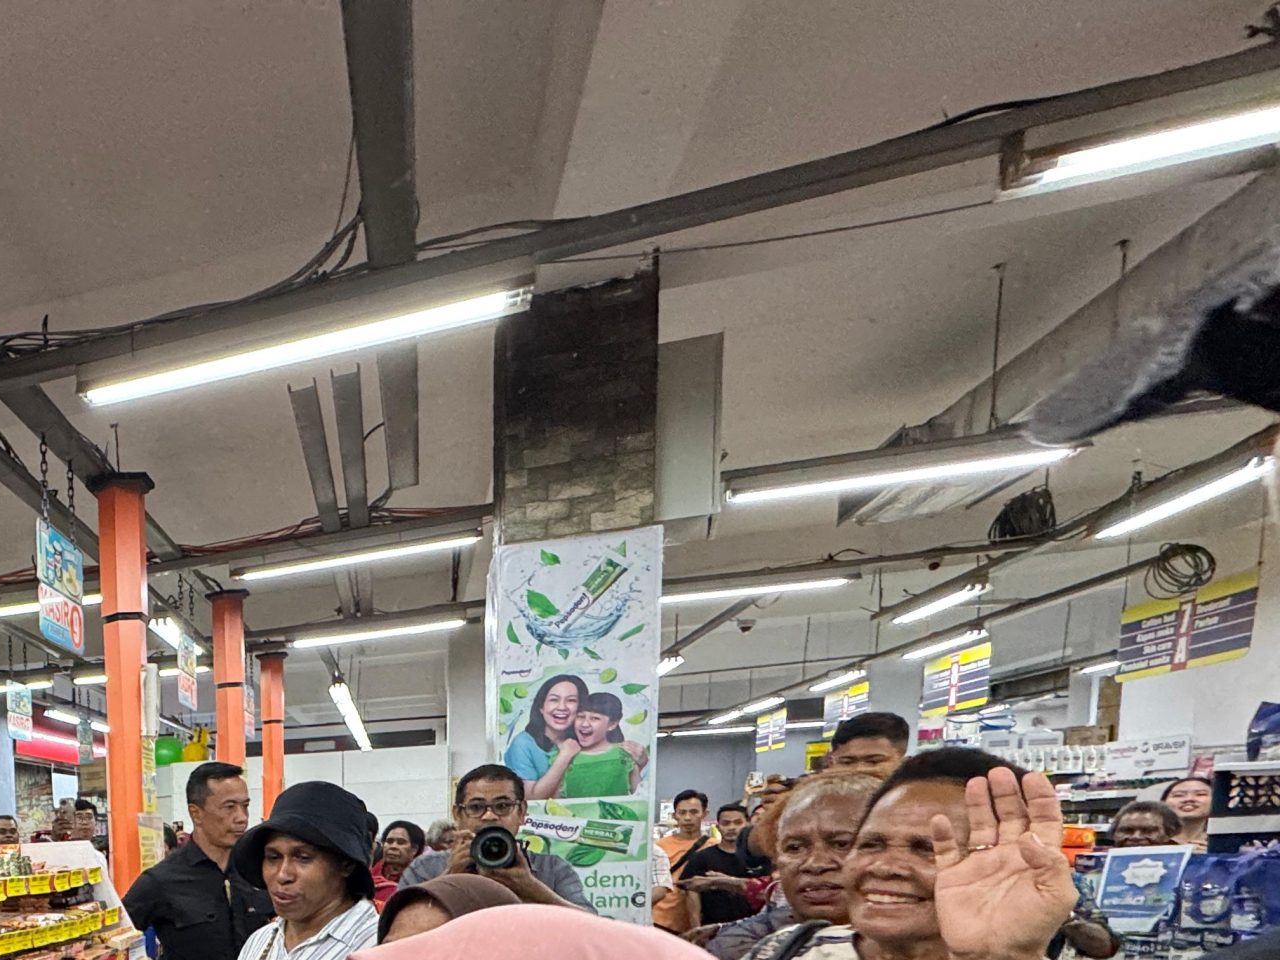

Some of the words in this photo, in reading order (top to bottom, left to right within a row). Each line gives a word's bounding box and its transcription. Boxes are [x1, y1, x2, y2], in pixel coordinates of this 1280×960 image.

[554, 592, 588, 629] Pepsodent
[1181, 602, 1193, 634] 7
[1173, 636, 1188, 665] A
[525, 817, 580, 833] Pepsodent
[583, 828, 615, 838] HERBAL
